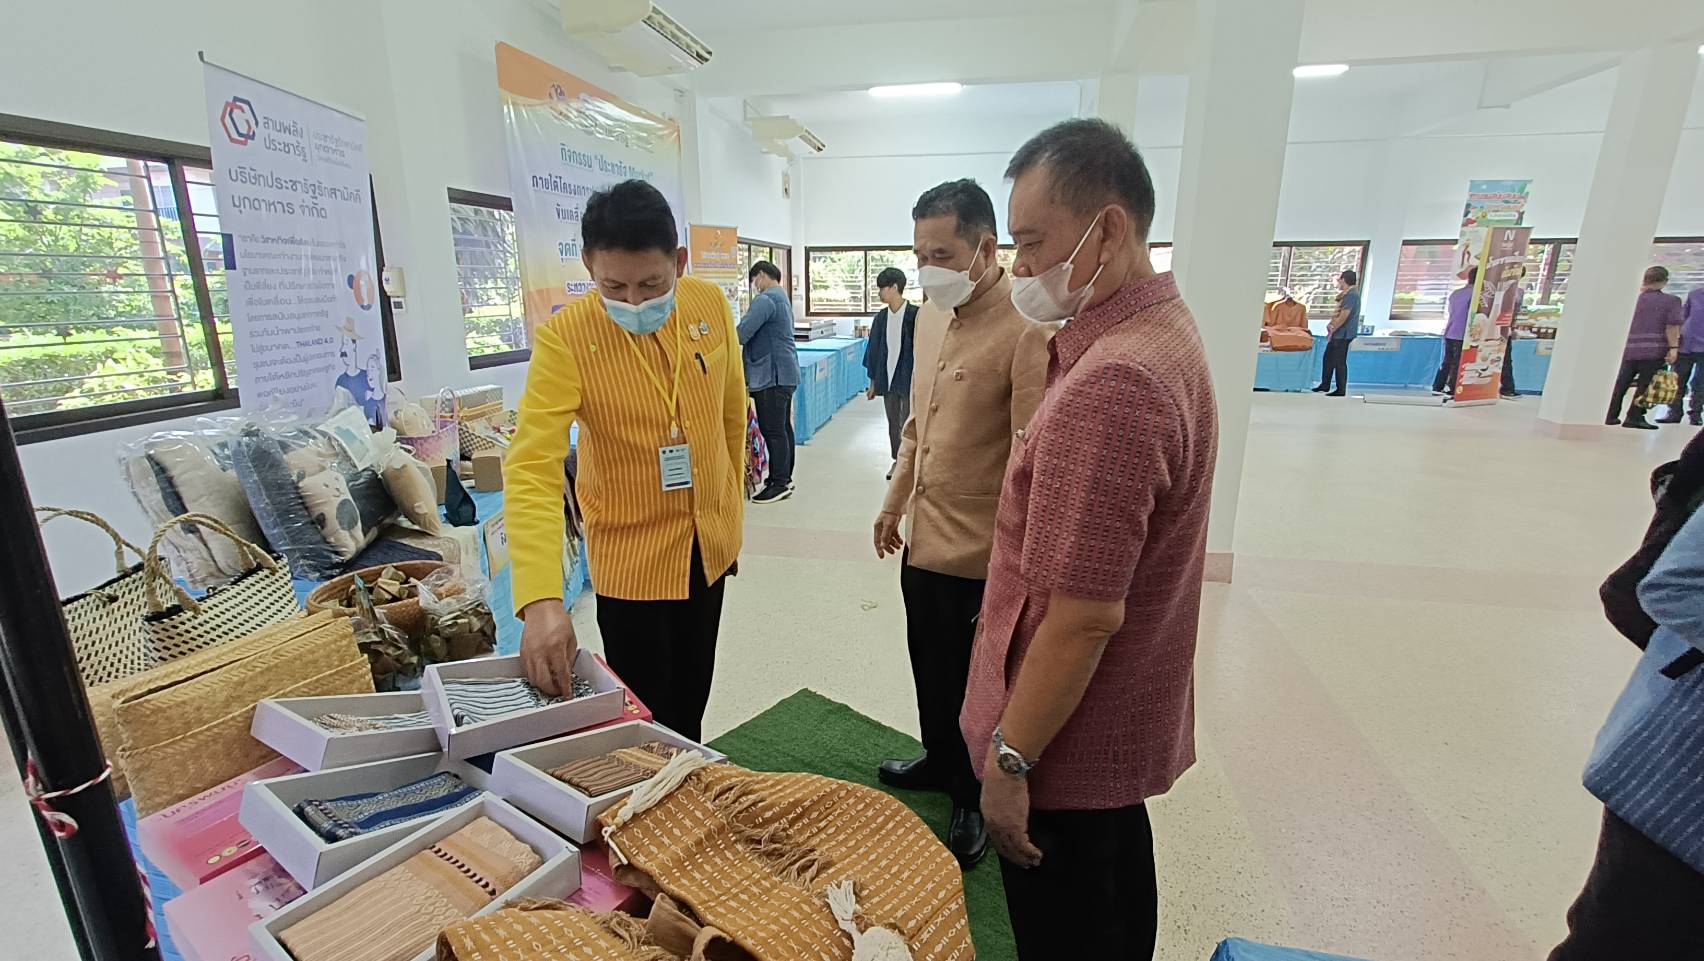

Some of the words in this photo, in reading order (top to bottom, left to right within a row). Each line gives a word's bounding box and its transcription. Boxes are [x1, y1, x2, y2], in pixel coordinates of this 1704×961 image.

[263, 116, 304, 139] สานพลัง
[264, 135, 308, 163] ประชารัฐ
[560, 142, 592, 169] กิจกรรม
[228, 165, 361, 204] บริษัทประชารัฐรักสามัคคี
[231, 194, 295, 215] มุกดาหาร
[299, 200, 328, 220] จำกัด
